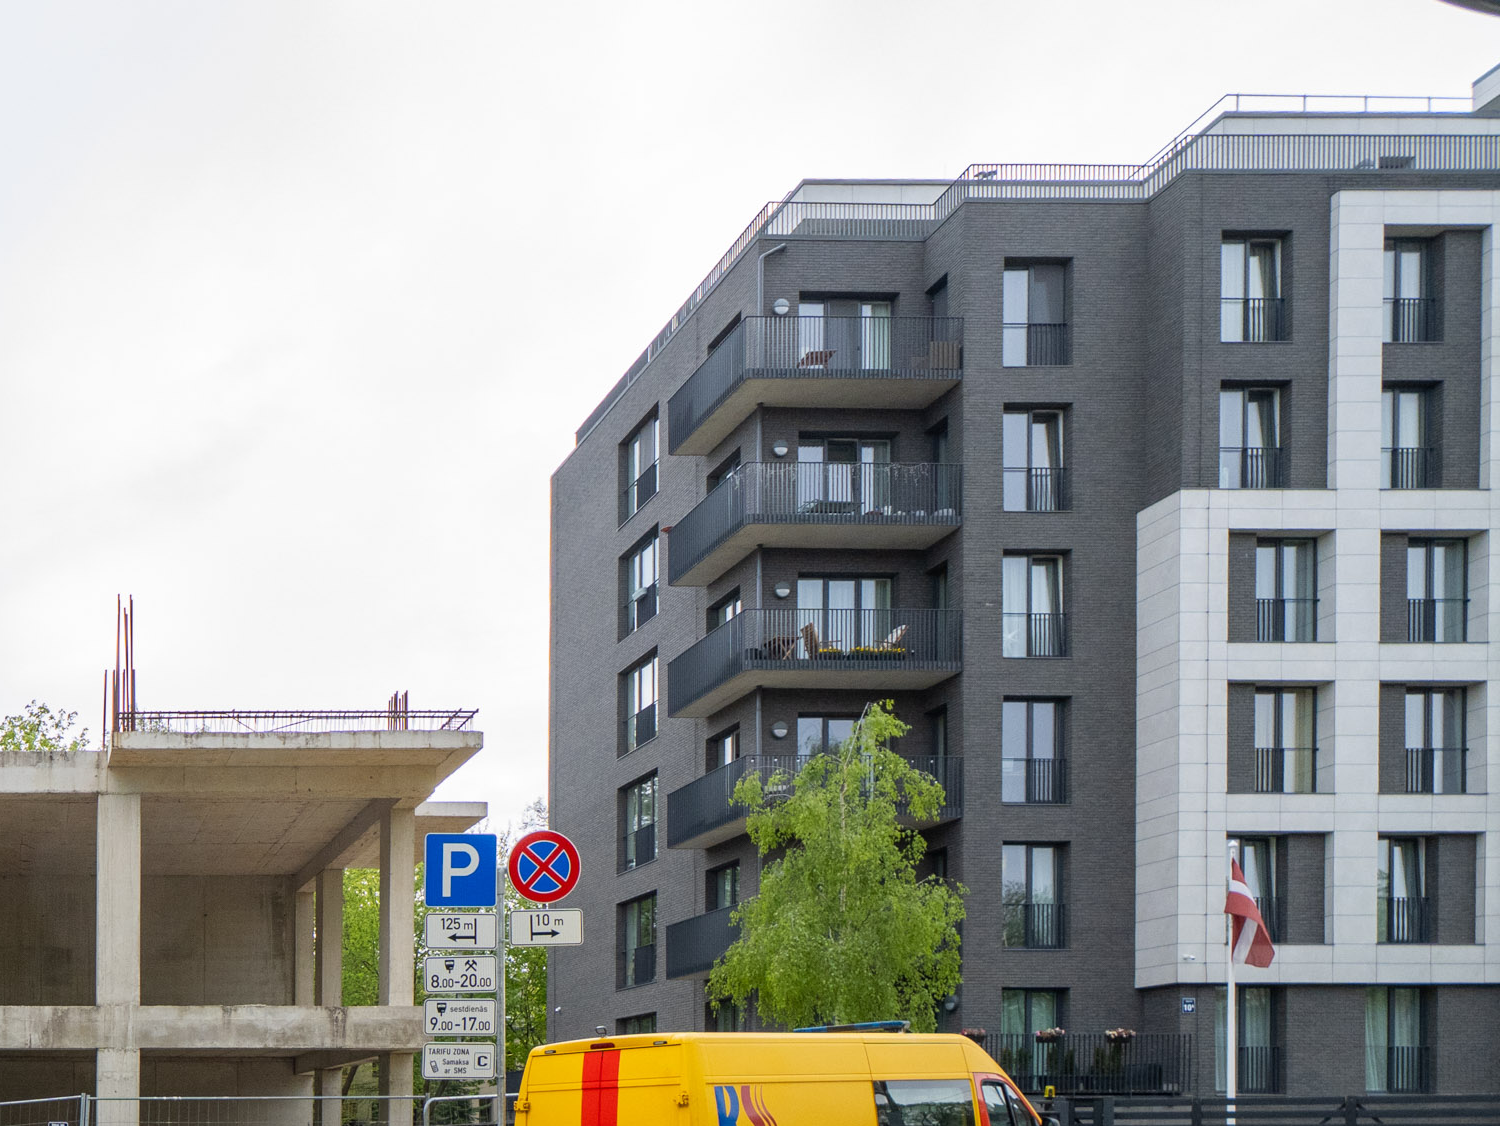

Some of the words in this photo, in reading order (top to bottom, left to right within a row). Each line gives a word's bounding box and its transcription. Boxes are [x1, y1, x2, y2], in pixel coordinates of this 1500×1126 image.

[442, 843, 480, 897] P
[441, 918, 461, 930] 125
[464, 922, 474, 930] m
[536, 914, 550, 926] 10
[554, 918, 564, 926] m
[431, 974, 492, 988] 8.00-20.00
[450, 1005, 488, 1013] sestdienās
[477, 1055, 488, 1067] C
